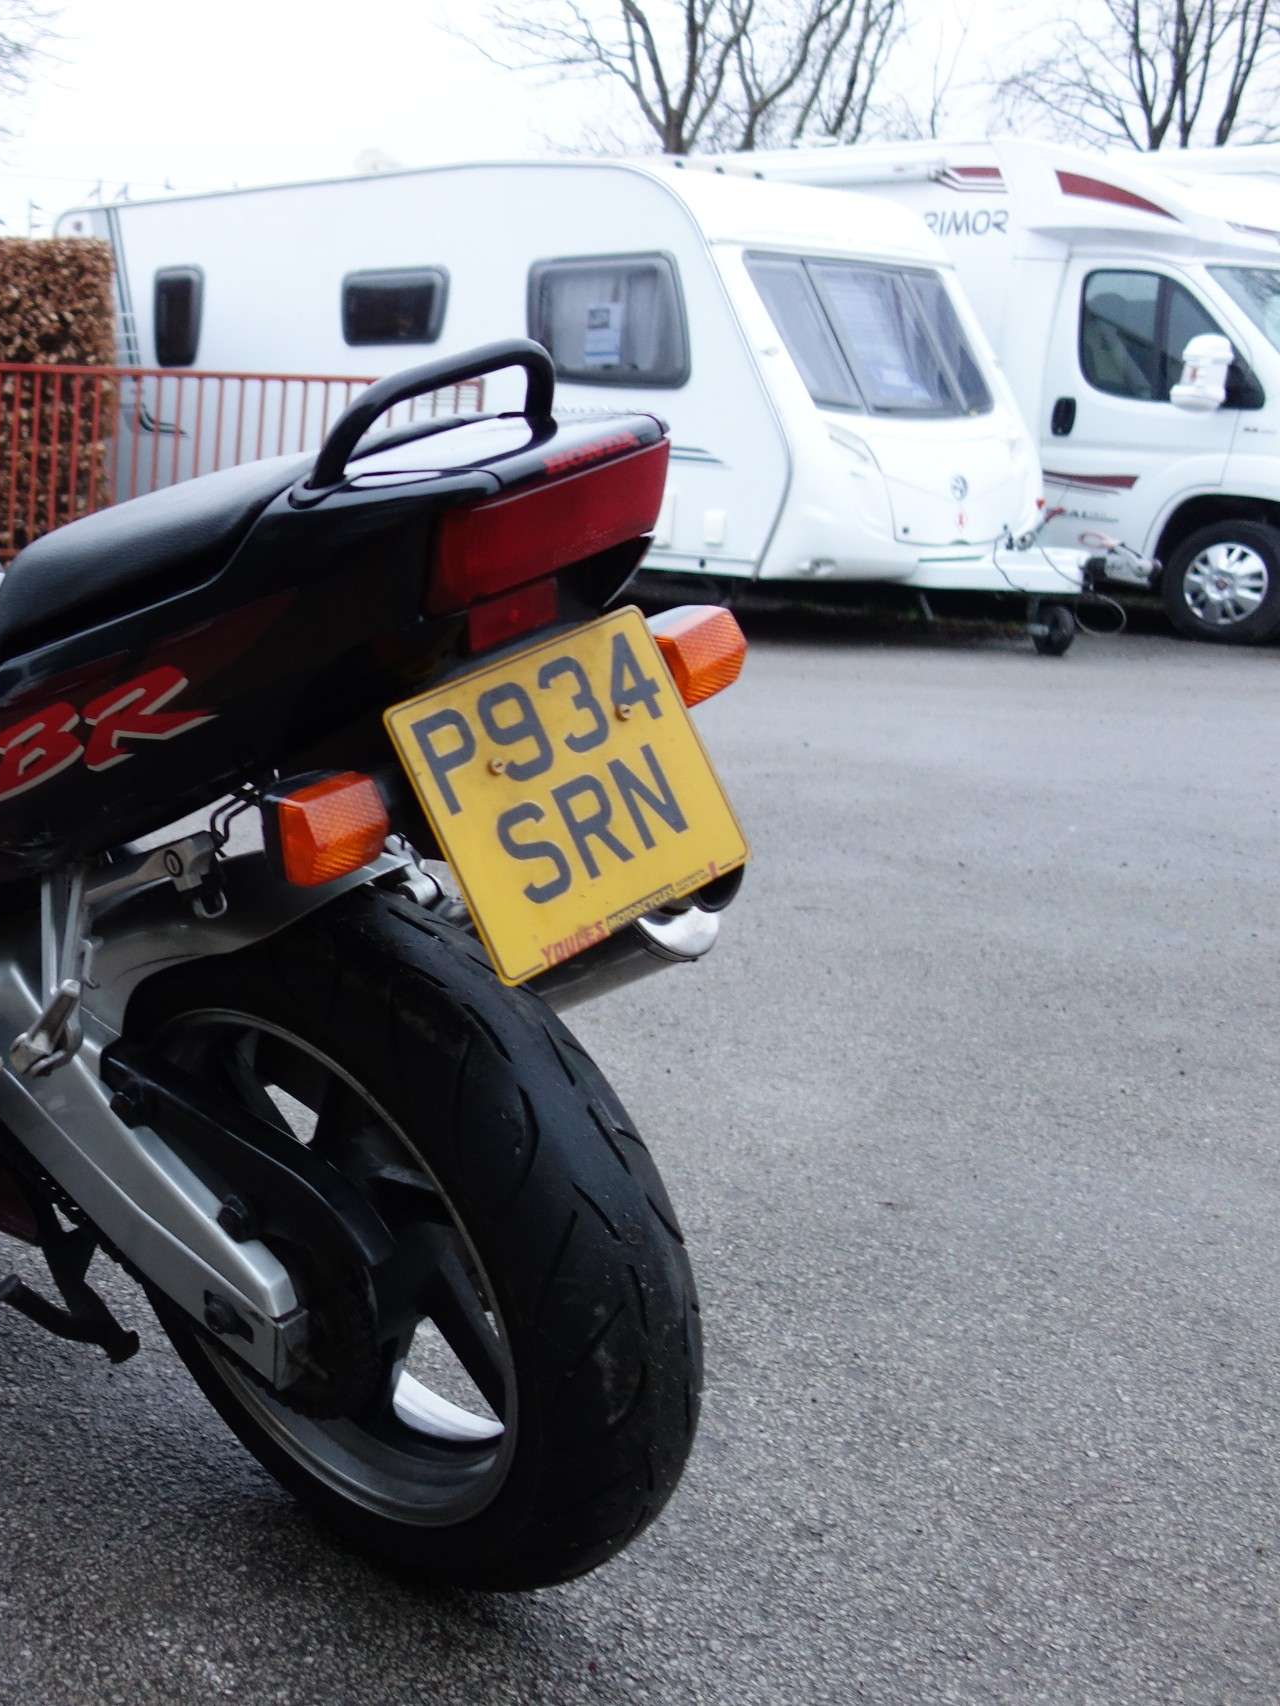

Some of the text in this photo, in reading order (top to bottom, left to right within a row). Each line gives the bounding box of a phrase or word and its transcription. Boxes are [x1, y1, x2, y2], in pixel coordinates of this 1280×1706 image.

[543, 431, 641, 475] HONDA
[410, 632, 662, 816] P934
[497, 744, 689, 904] SRN
